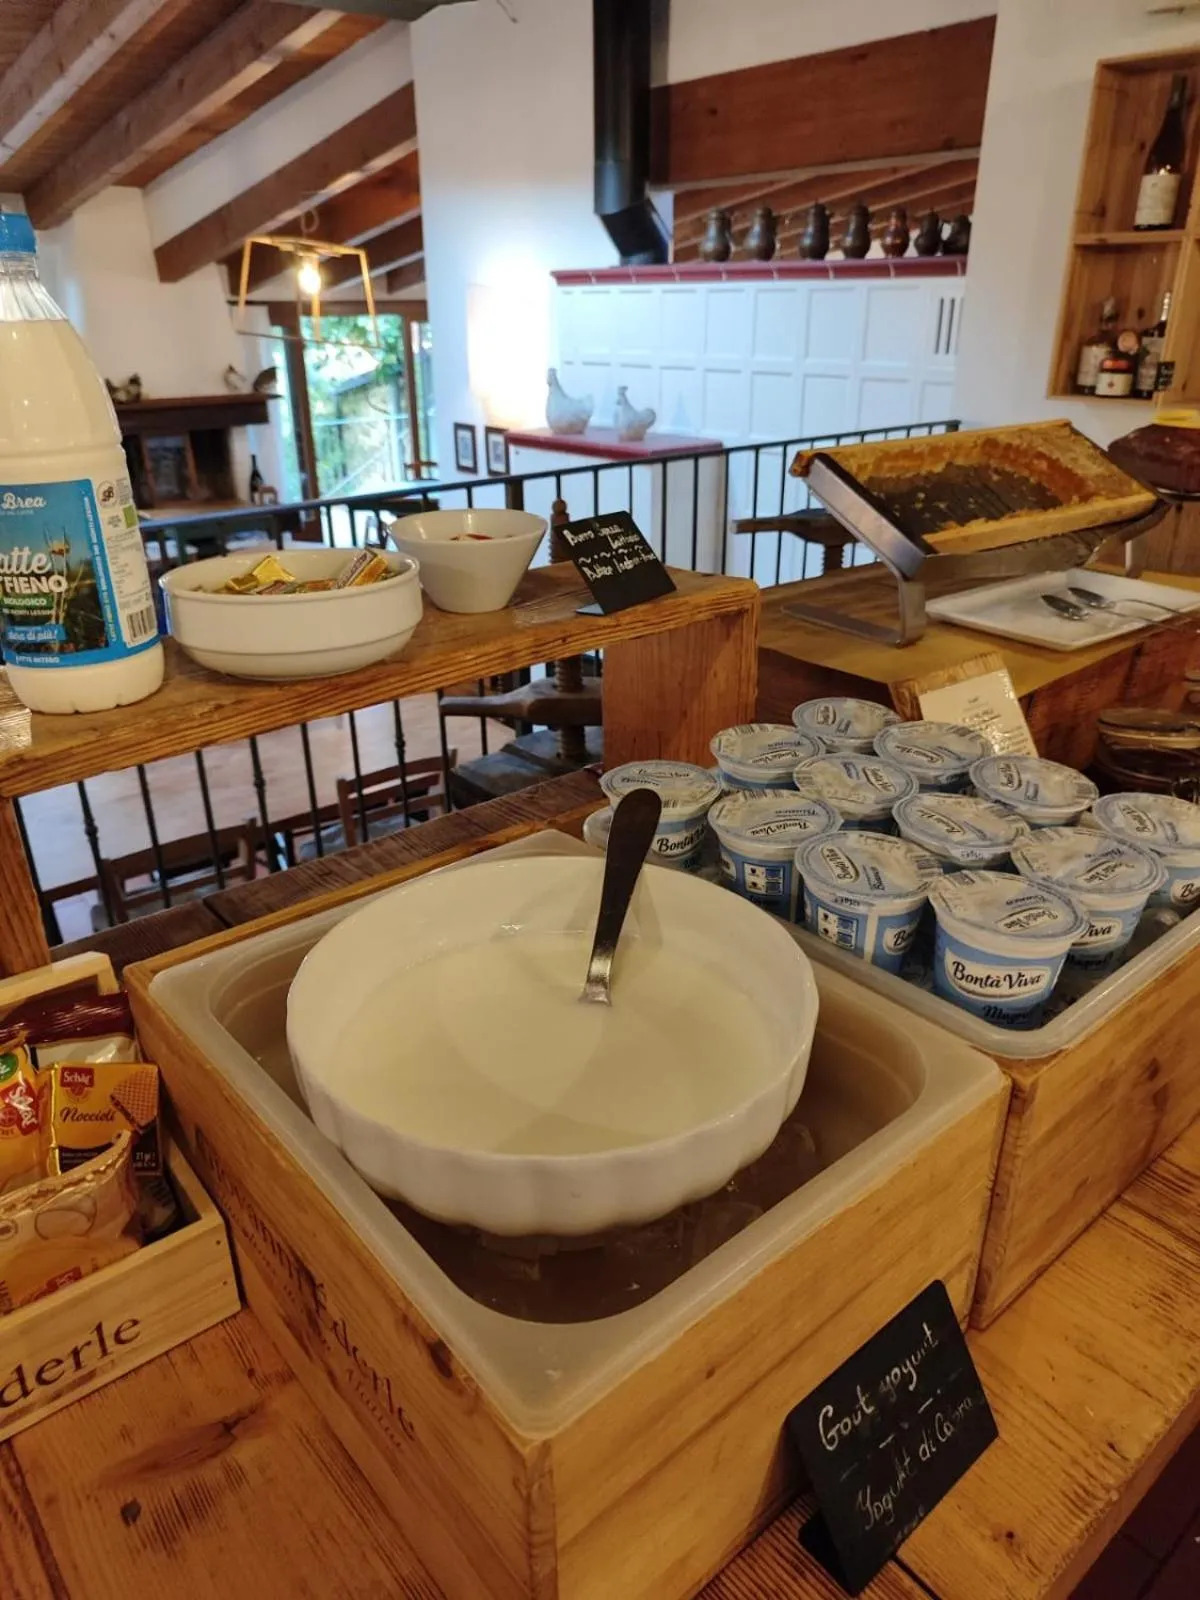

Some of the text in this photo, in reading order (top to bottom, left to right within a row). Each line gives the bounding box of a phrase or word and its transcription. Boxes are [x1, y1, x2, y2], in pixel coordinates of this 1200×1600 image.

[2, 493, 47, 510] Brea
[5, 575, 68, 595] FIENO
[951, 960, 1042, 989] Bontà Viva
[0, 1318, 141, 1408] derle
[918, 1434, 937, 1462] di
[934, 1396, 974, 1444] Cara
